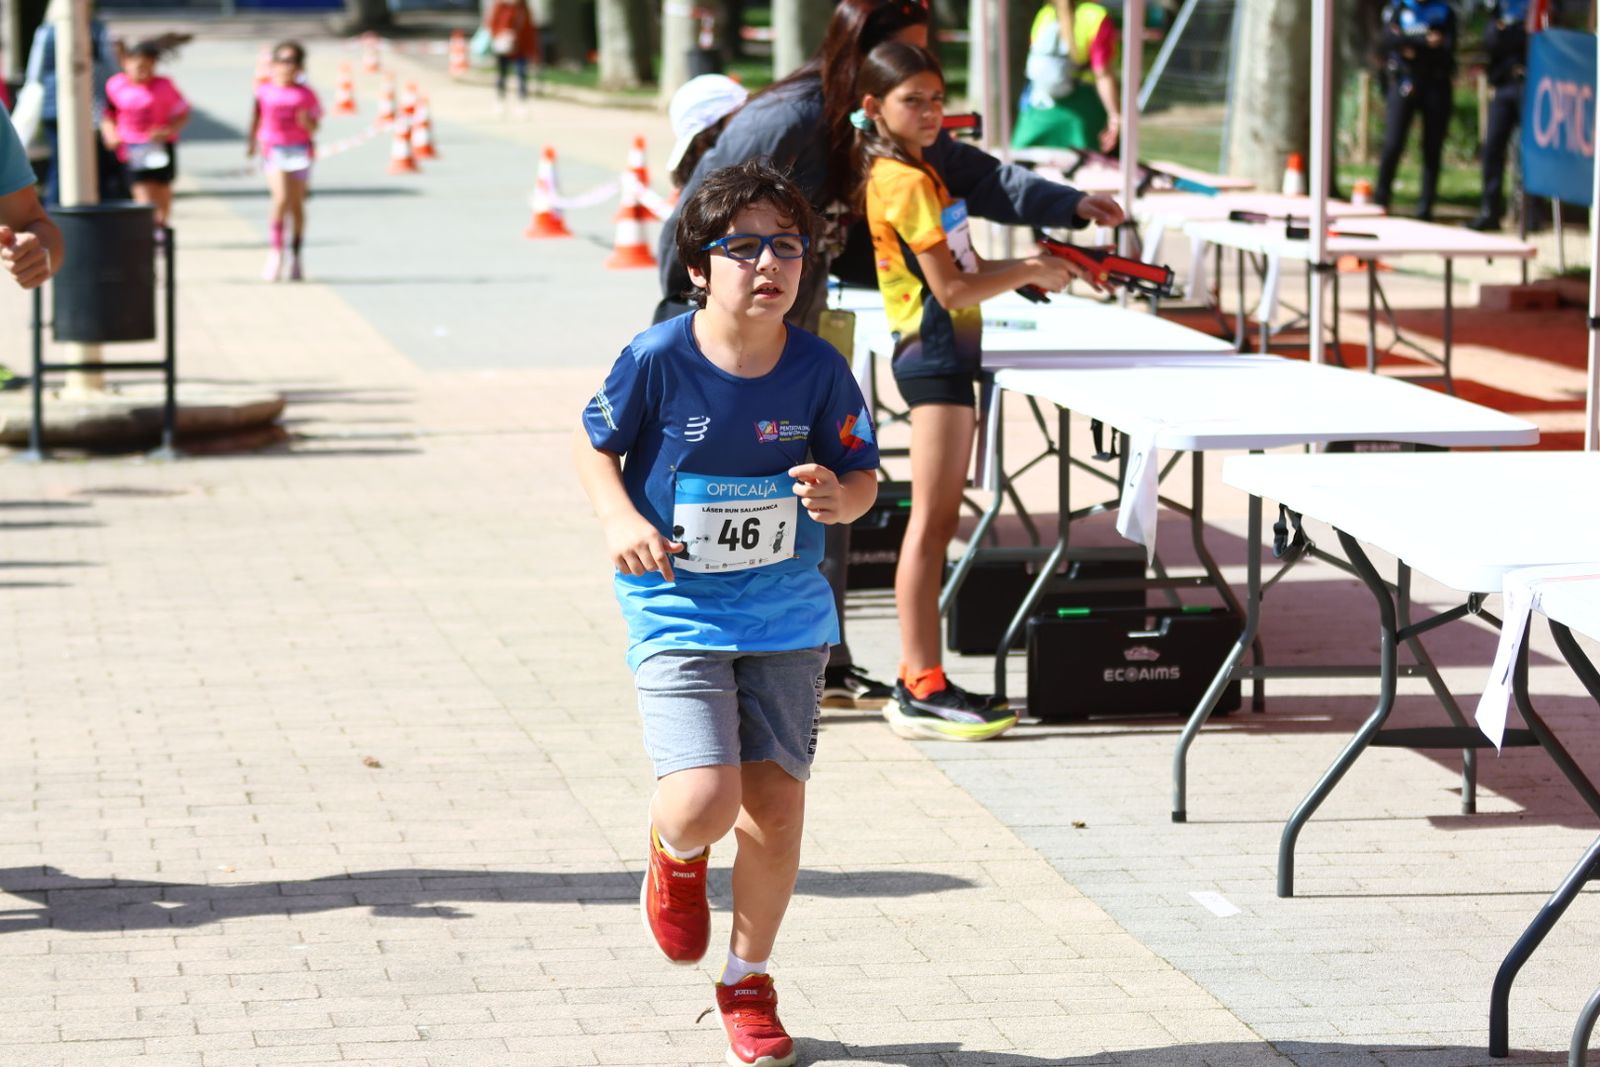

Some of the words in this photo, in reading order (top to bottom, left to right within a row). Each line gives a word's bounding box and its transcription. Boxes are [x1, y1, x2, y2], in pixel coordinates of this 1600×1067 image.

[1532, 77, 1594, 157] OPTIC
[702, 506, 724, 514] LÁSER
[740, 503, 778, 513] SALAMANCA
[717, 517, 761, 552] 46
[1103, 665, 1181, 683] ECOAIMS
